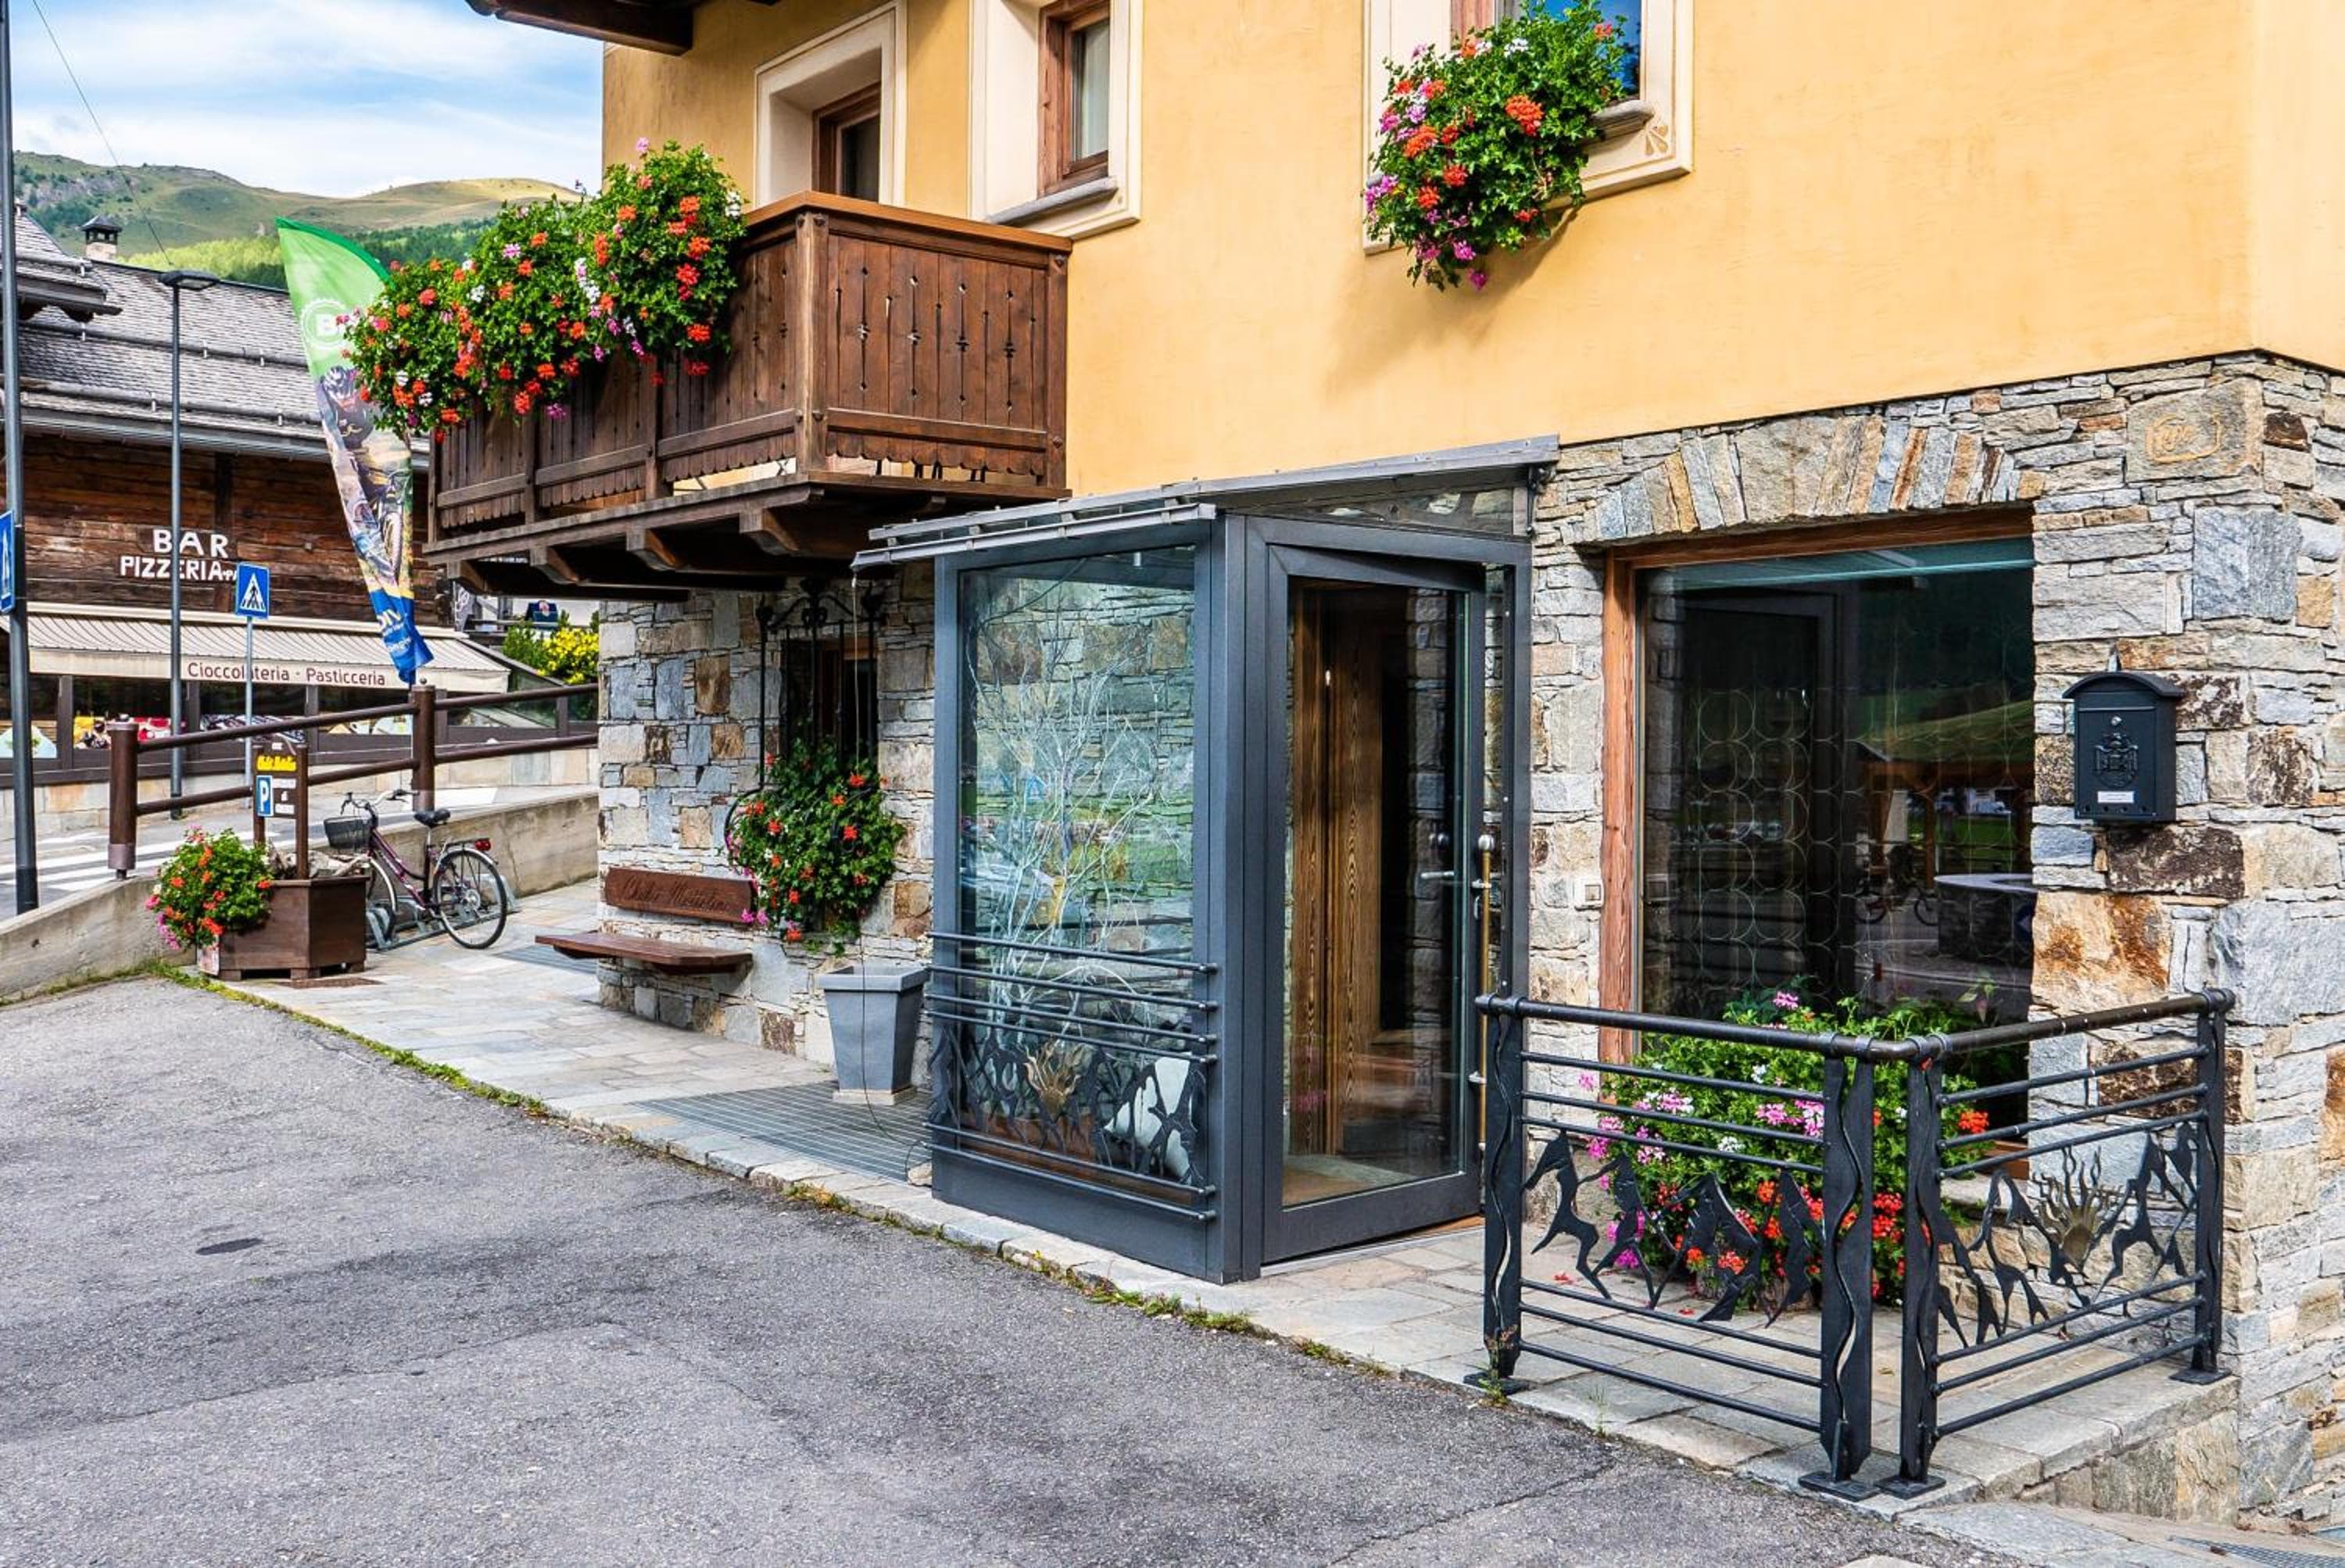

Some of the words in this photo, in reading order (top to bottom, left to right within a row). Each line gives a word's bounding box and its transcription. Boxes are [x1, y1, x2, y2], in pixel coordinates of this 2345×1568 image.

[152, 529, 229, 559] BAR
[306, 668, 385, 686] Pasticceria
[260, 779, 270, 813] P
